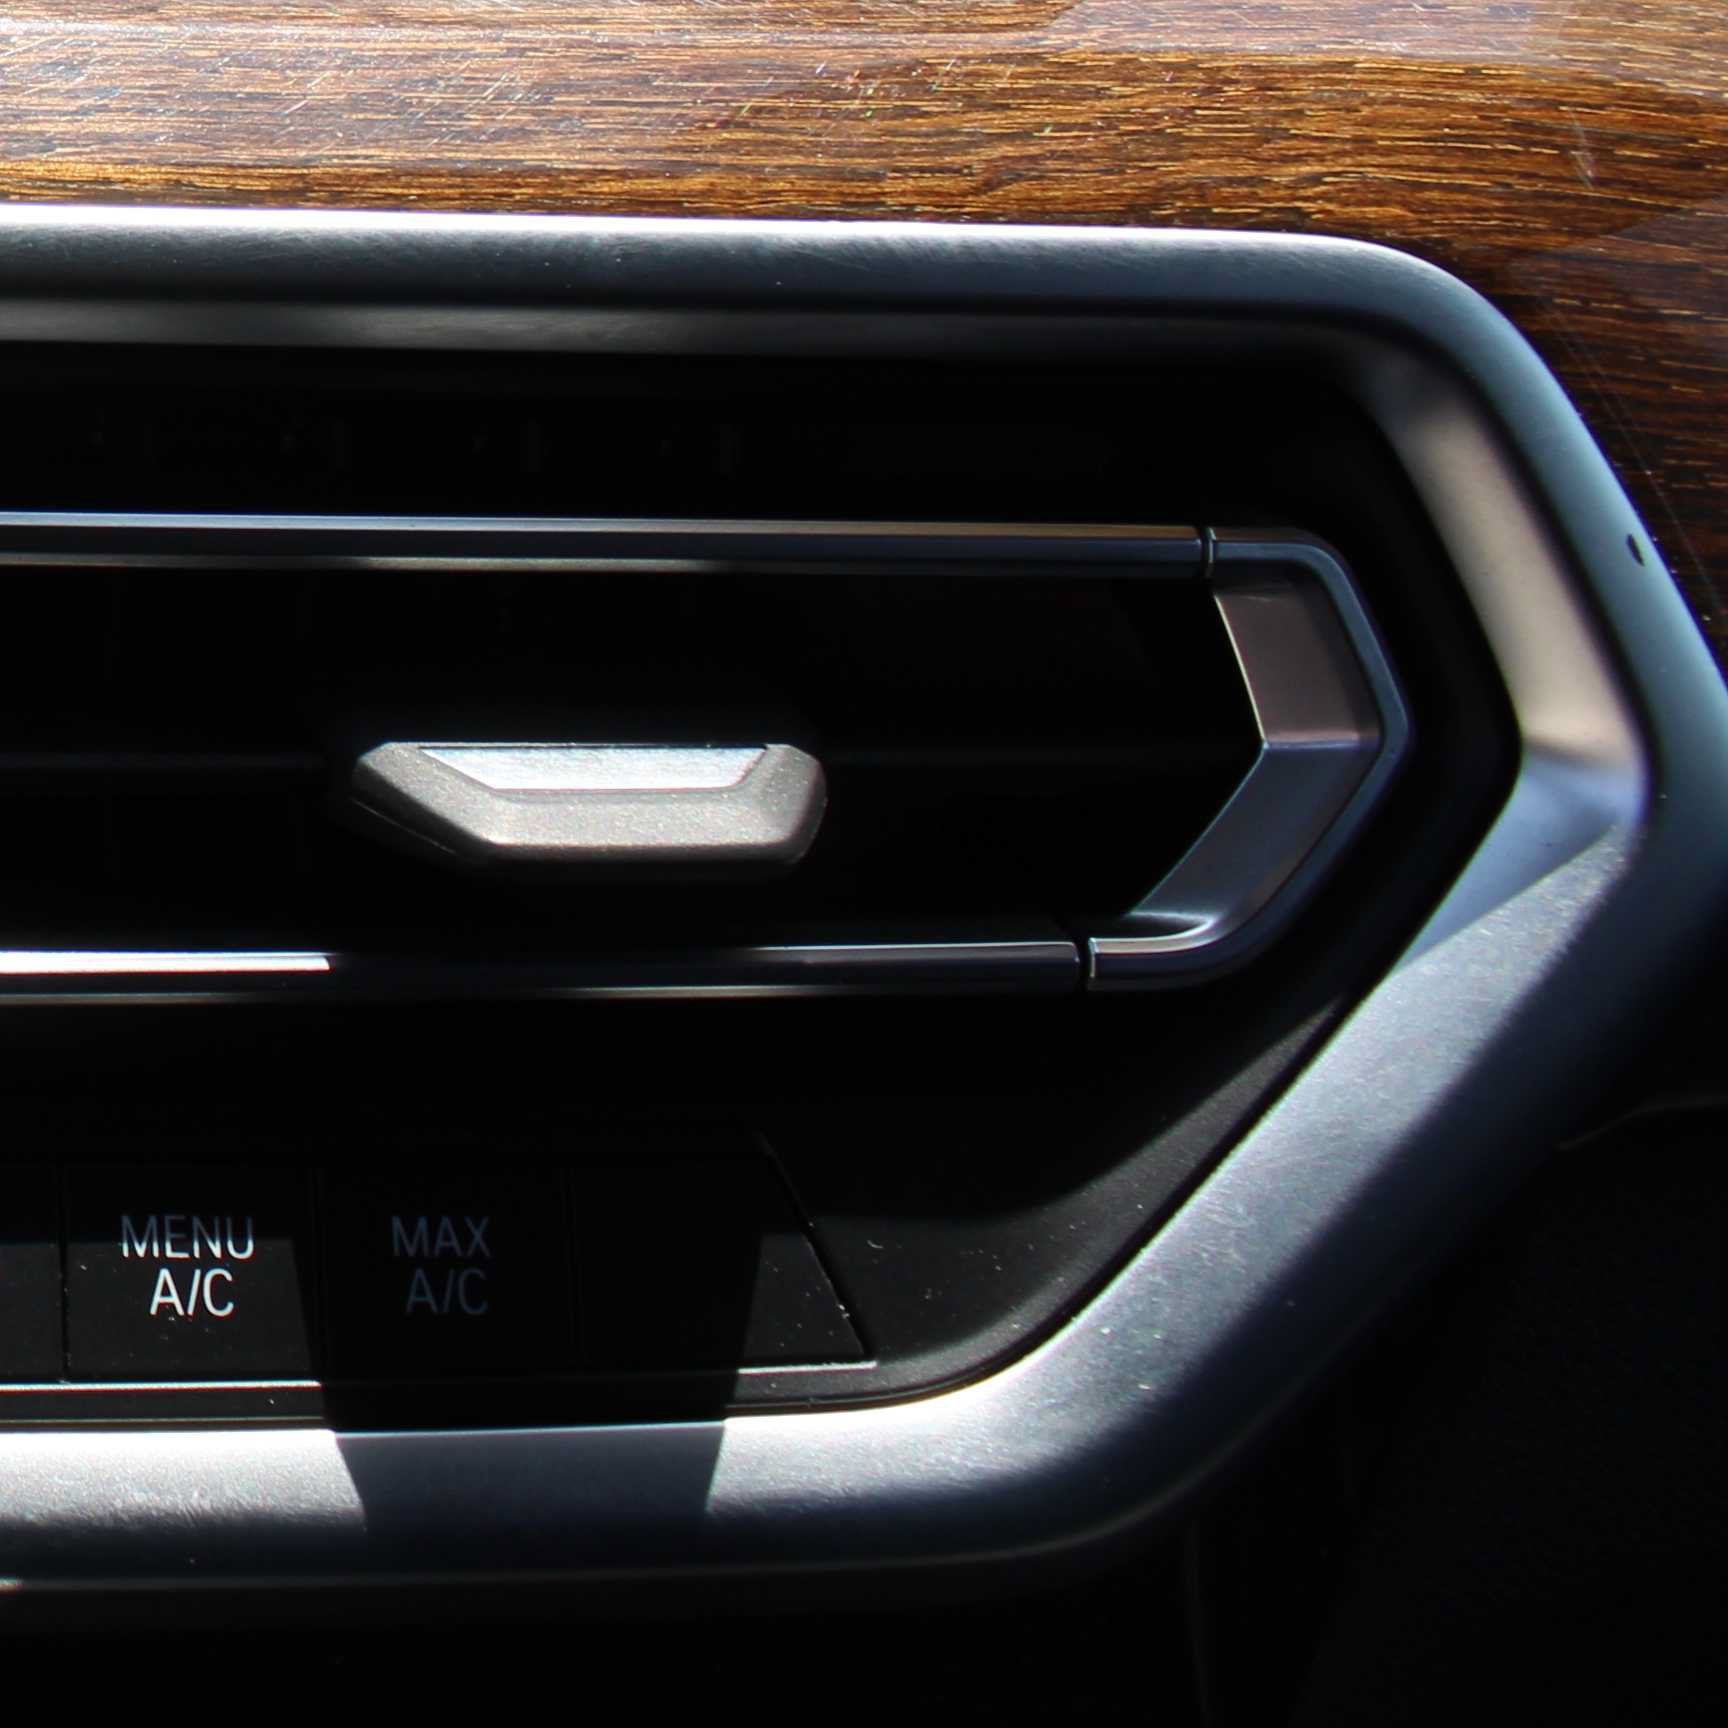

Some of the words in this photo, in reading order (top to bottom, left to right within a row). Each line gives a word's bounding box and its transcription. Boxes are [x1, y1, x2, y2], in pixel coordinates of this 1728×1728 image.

[119, 1214, 255, 1260] MENU
[389, 1215, 492, 1259] MAX
[148, 1267, 236, 1317] A/C
[404, 1267, 489, 1316] A/C
